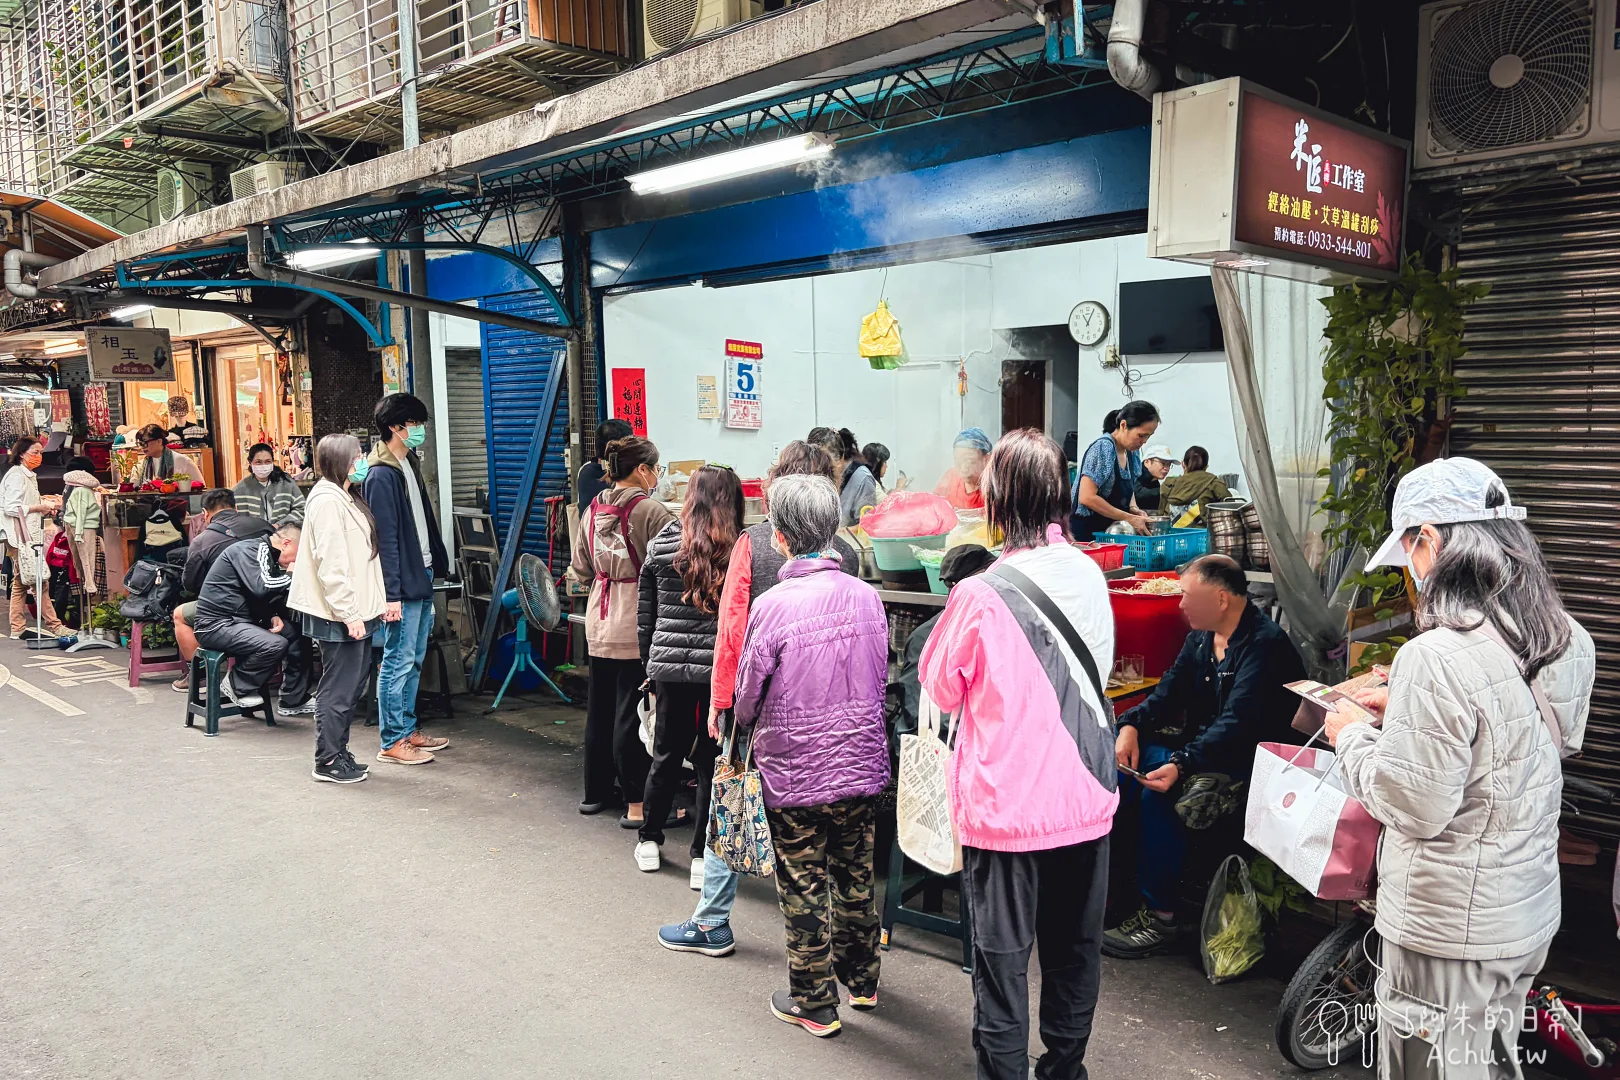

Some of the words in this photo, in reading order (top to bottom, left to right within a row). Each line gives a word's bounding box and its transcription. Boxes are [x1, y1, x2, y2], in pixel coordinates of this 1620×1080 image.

[1331, 164, 1366, 194] 工作室
[737, 362, 755, 393] 5
